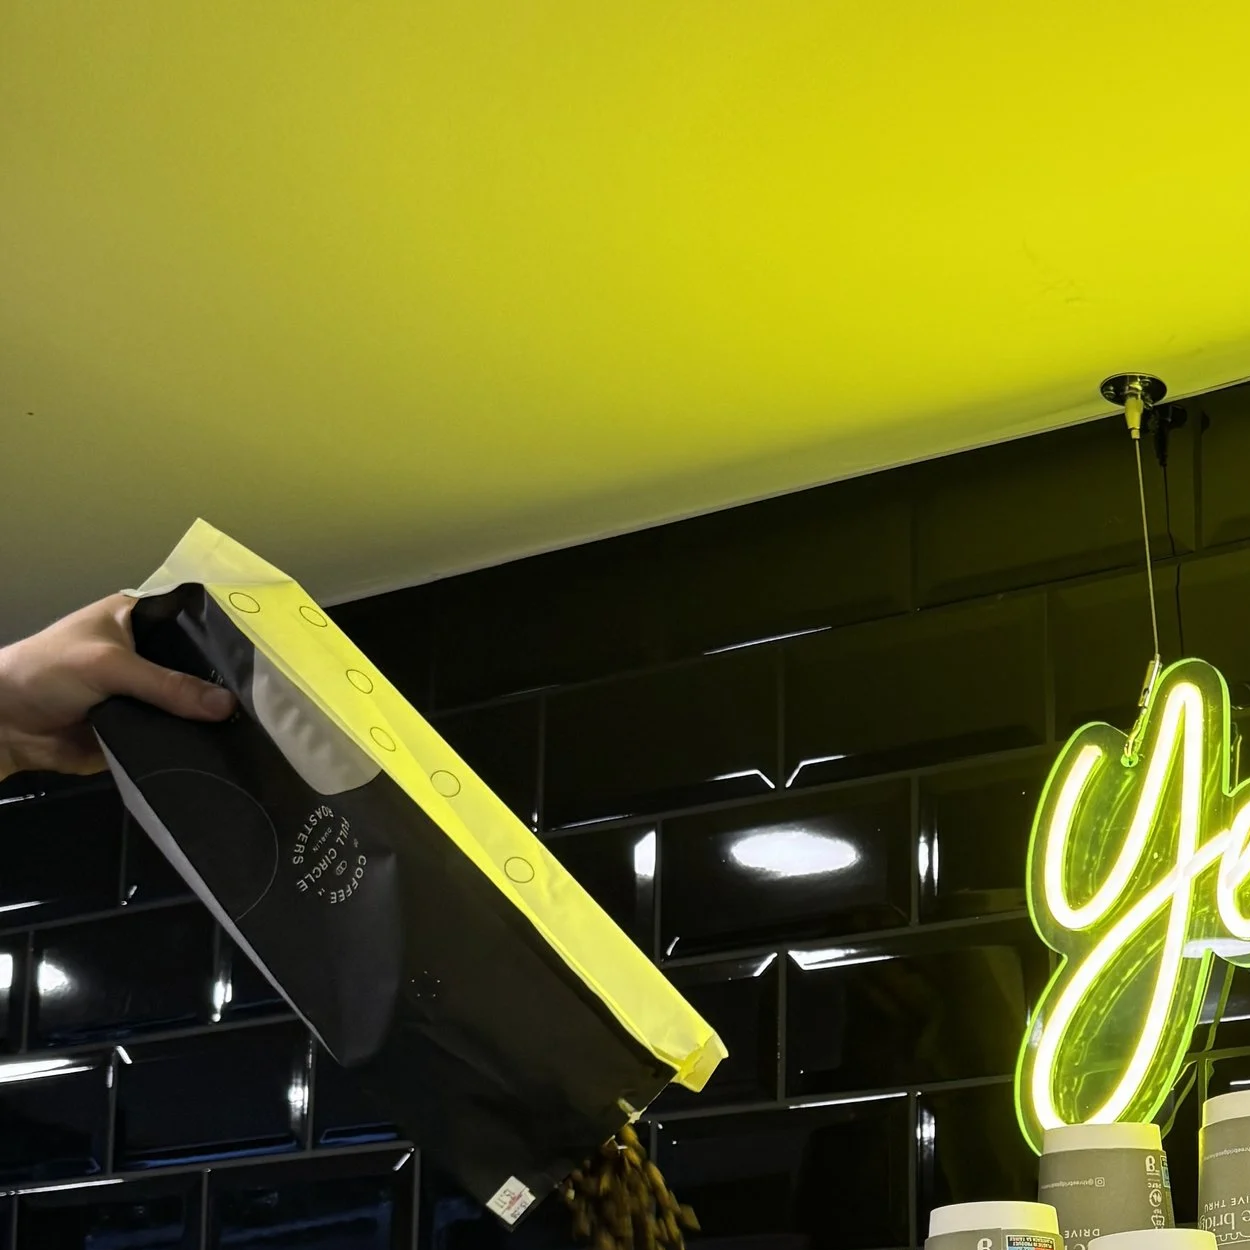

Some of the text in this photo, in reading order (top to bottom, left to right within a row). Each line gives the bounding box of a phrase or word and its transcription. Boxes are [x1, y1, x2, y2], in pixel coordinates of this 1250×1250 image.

[292, 805, 334, 865] ROASTERS
[296, 816, 350, 892] FULL CIRCLE
[330, 855, 367, 904] COFFEE
[1204, 1199, 1226, 1213] THRU
[1064, 1228, 1100, 1239] DRIVE
